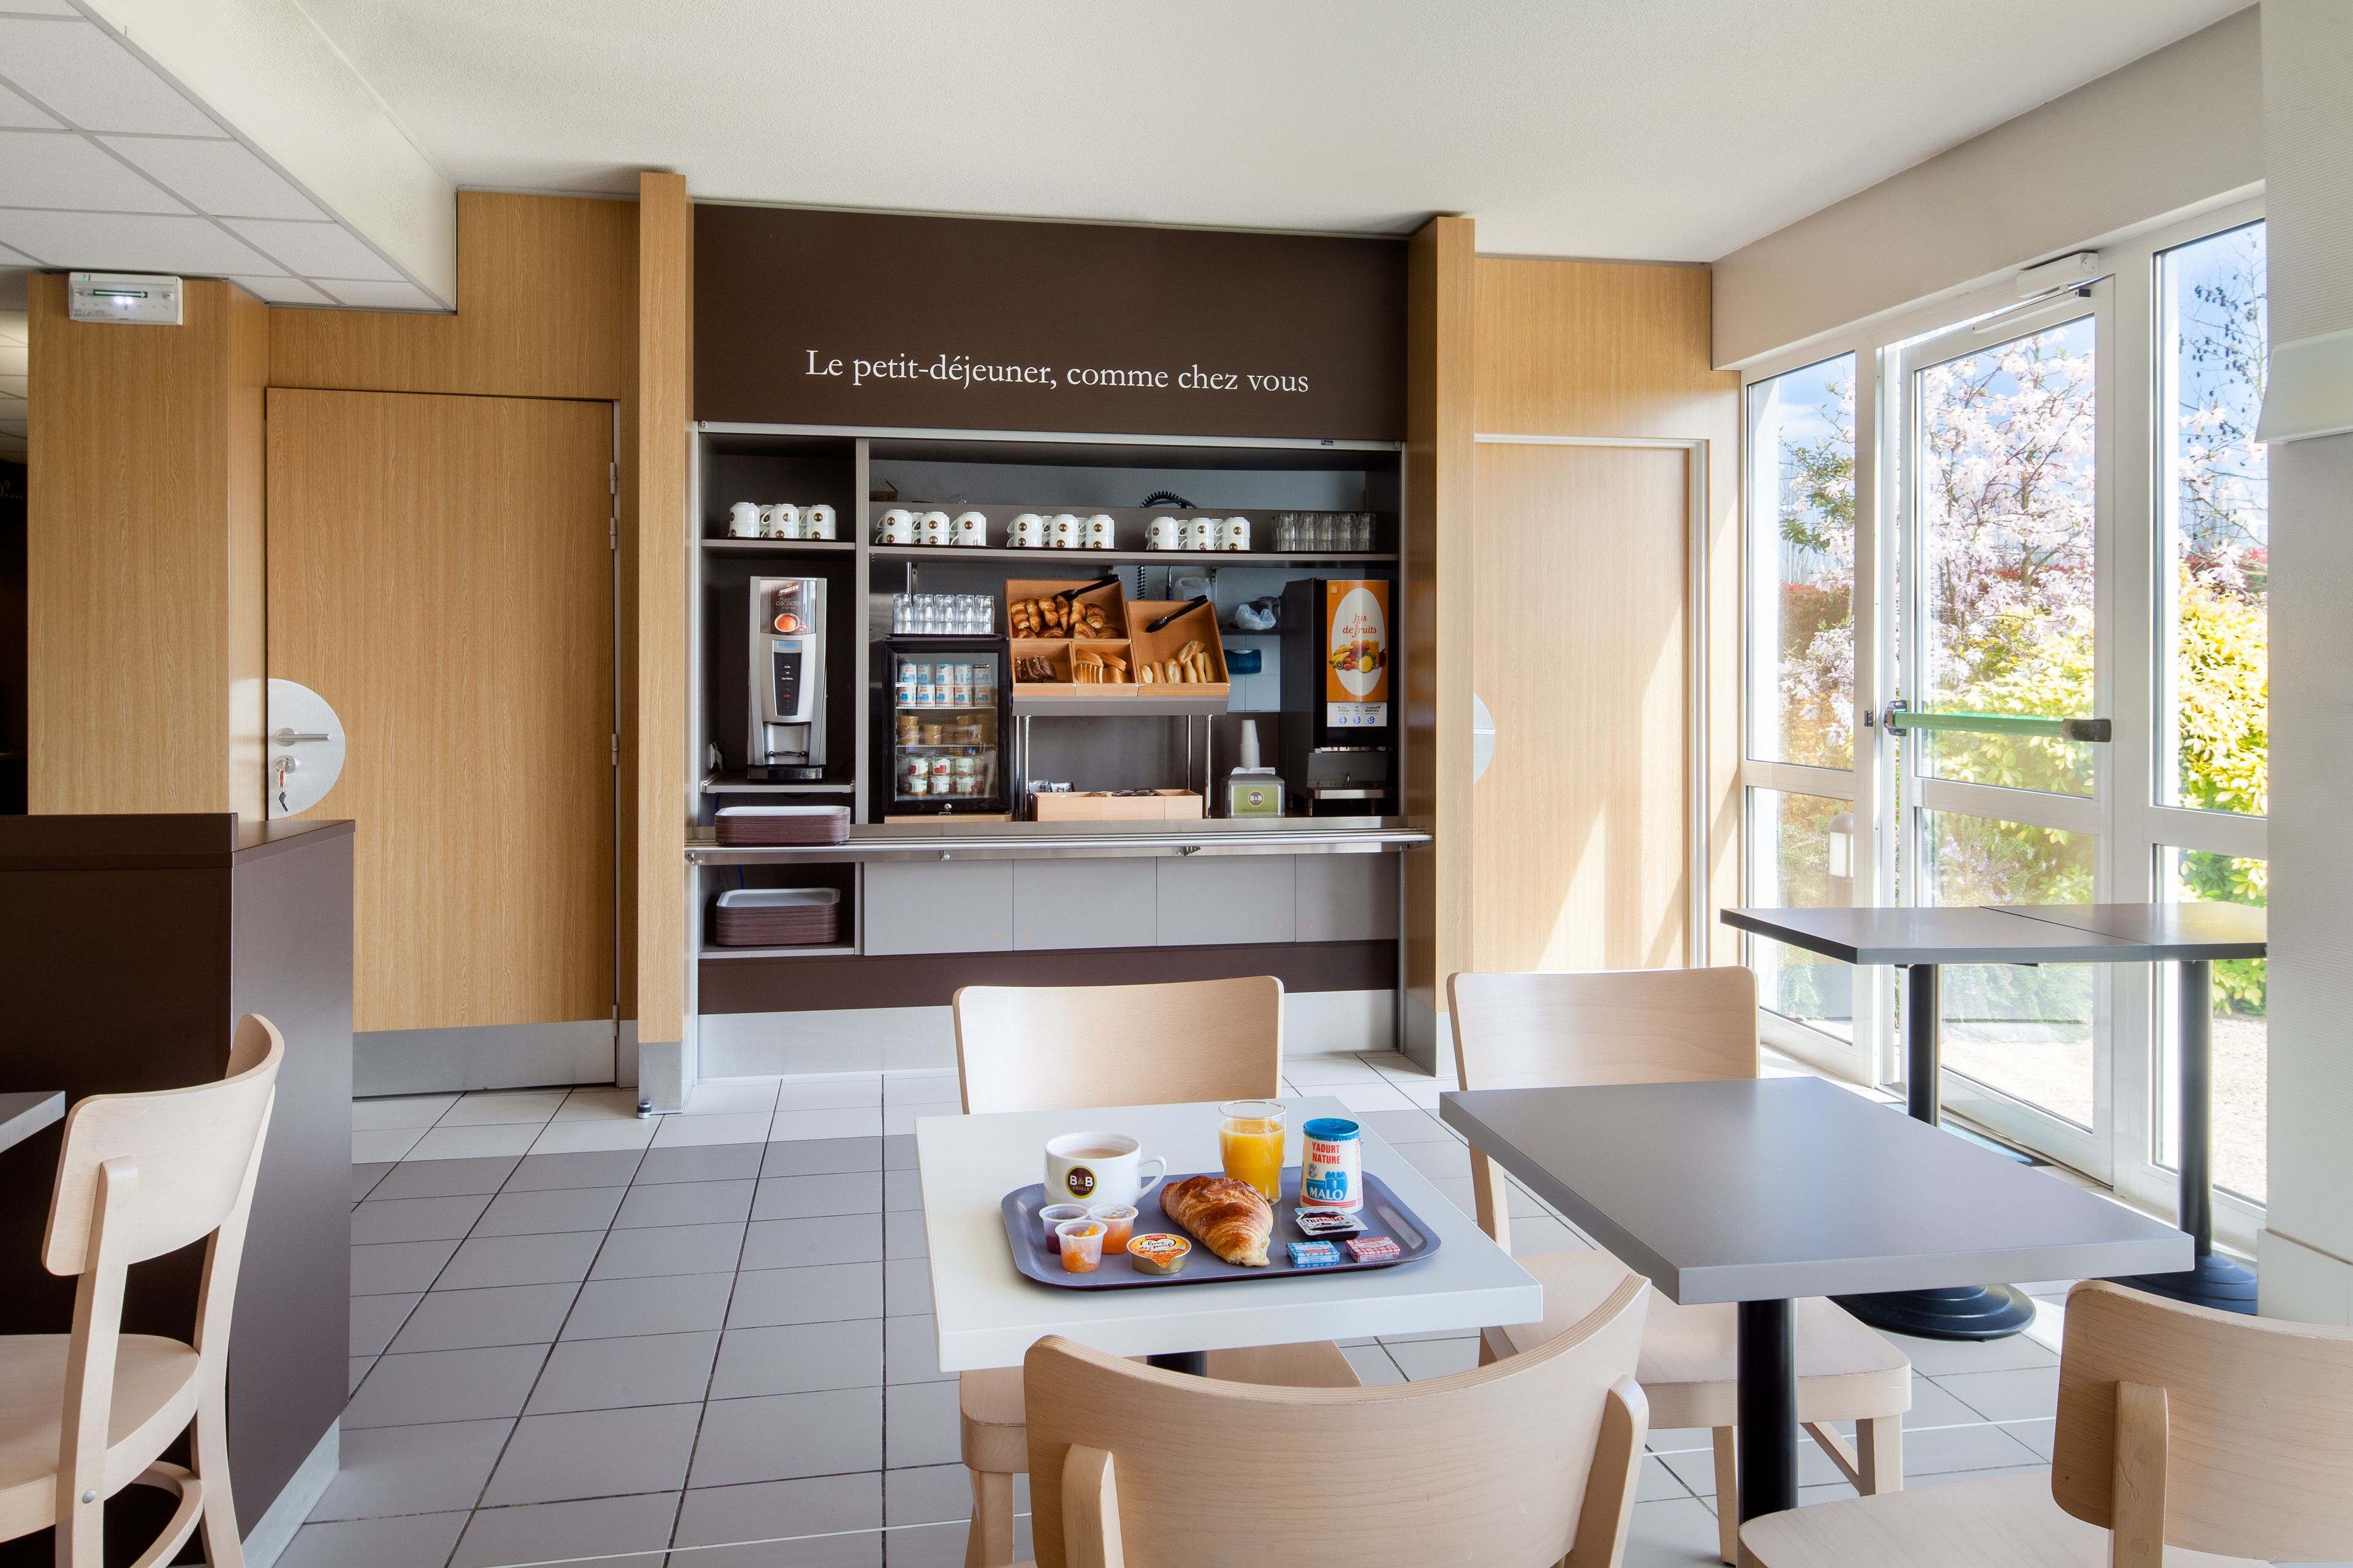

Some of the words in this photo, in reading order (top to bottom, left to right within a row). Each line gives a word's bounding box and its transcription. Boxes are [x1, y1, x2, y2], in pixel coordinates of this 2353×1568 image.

[805, 349, 844, 376] Le
[852, 352, 1058, 390] petit-déjeuner,
[1066, 367, 1170, 388] comme
[1177, 363, 1239, 391] chez
[1246, 373, 1310, 393] vous
[1352, 613, 1368, 624] Jus
[1343, 626, 1354, 634] de
[1351, 622, 1377, 638] fruits
[1312, 1142, 1341, 1154] YAOURT
[1312, 1153, 1341, 1164] NATURE
[1069, 1175, 1094, 1187] B&B
[1309, 1186, 1344, 1201] MALO
